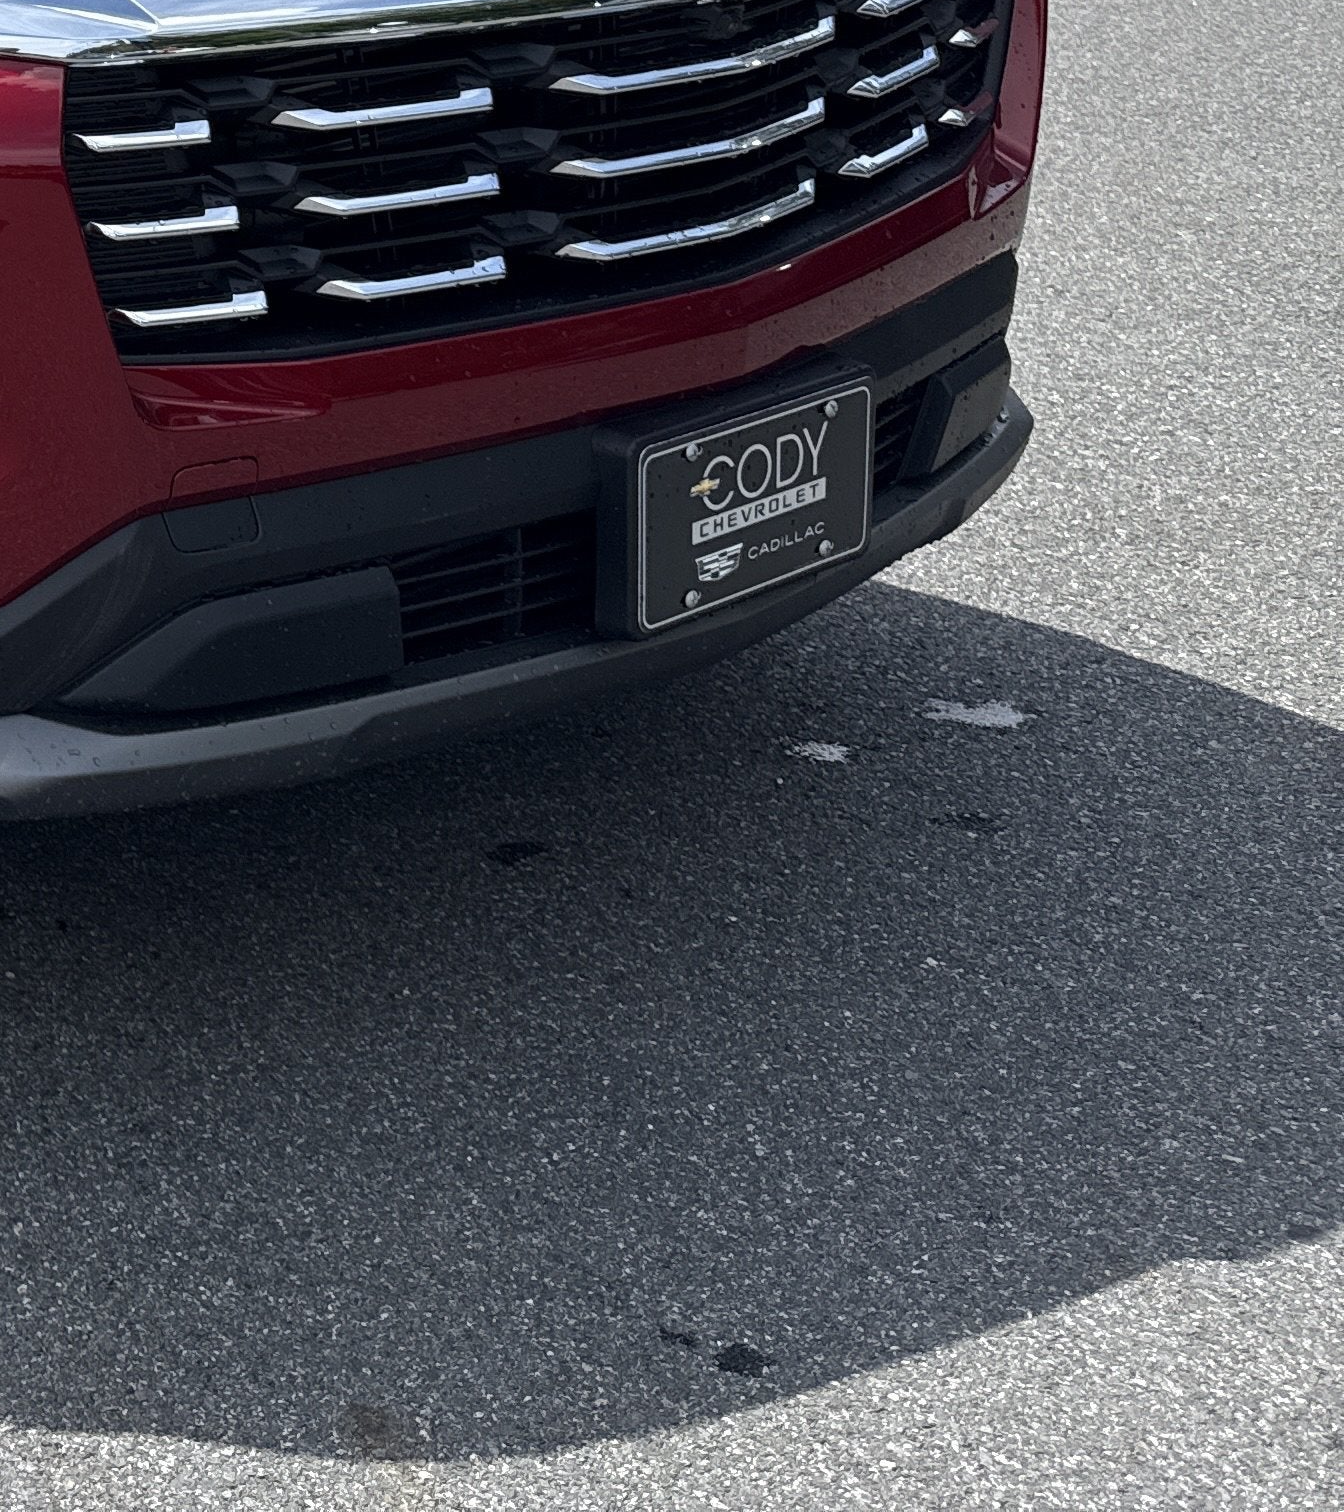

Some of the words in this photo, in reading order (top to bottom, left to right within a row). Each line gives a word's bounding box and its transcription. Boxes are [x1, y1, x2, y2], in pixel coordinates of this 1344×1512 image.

[702, 420, 829, 511] CODY
[699, 483, 820, 538] CHEVROLET
[747, 521, 826, 560] CADILLAC
